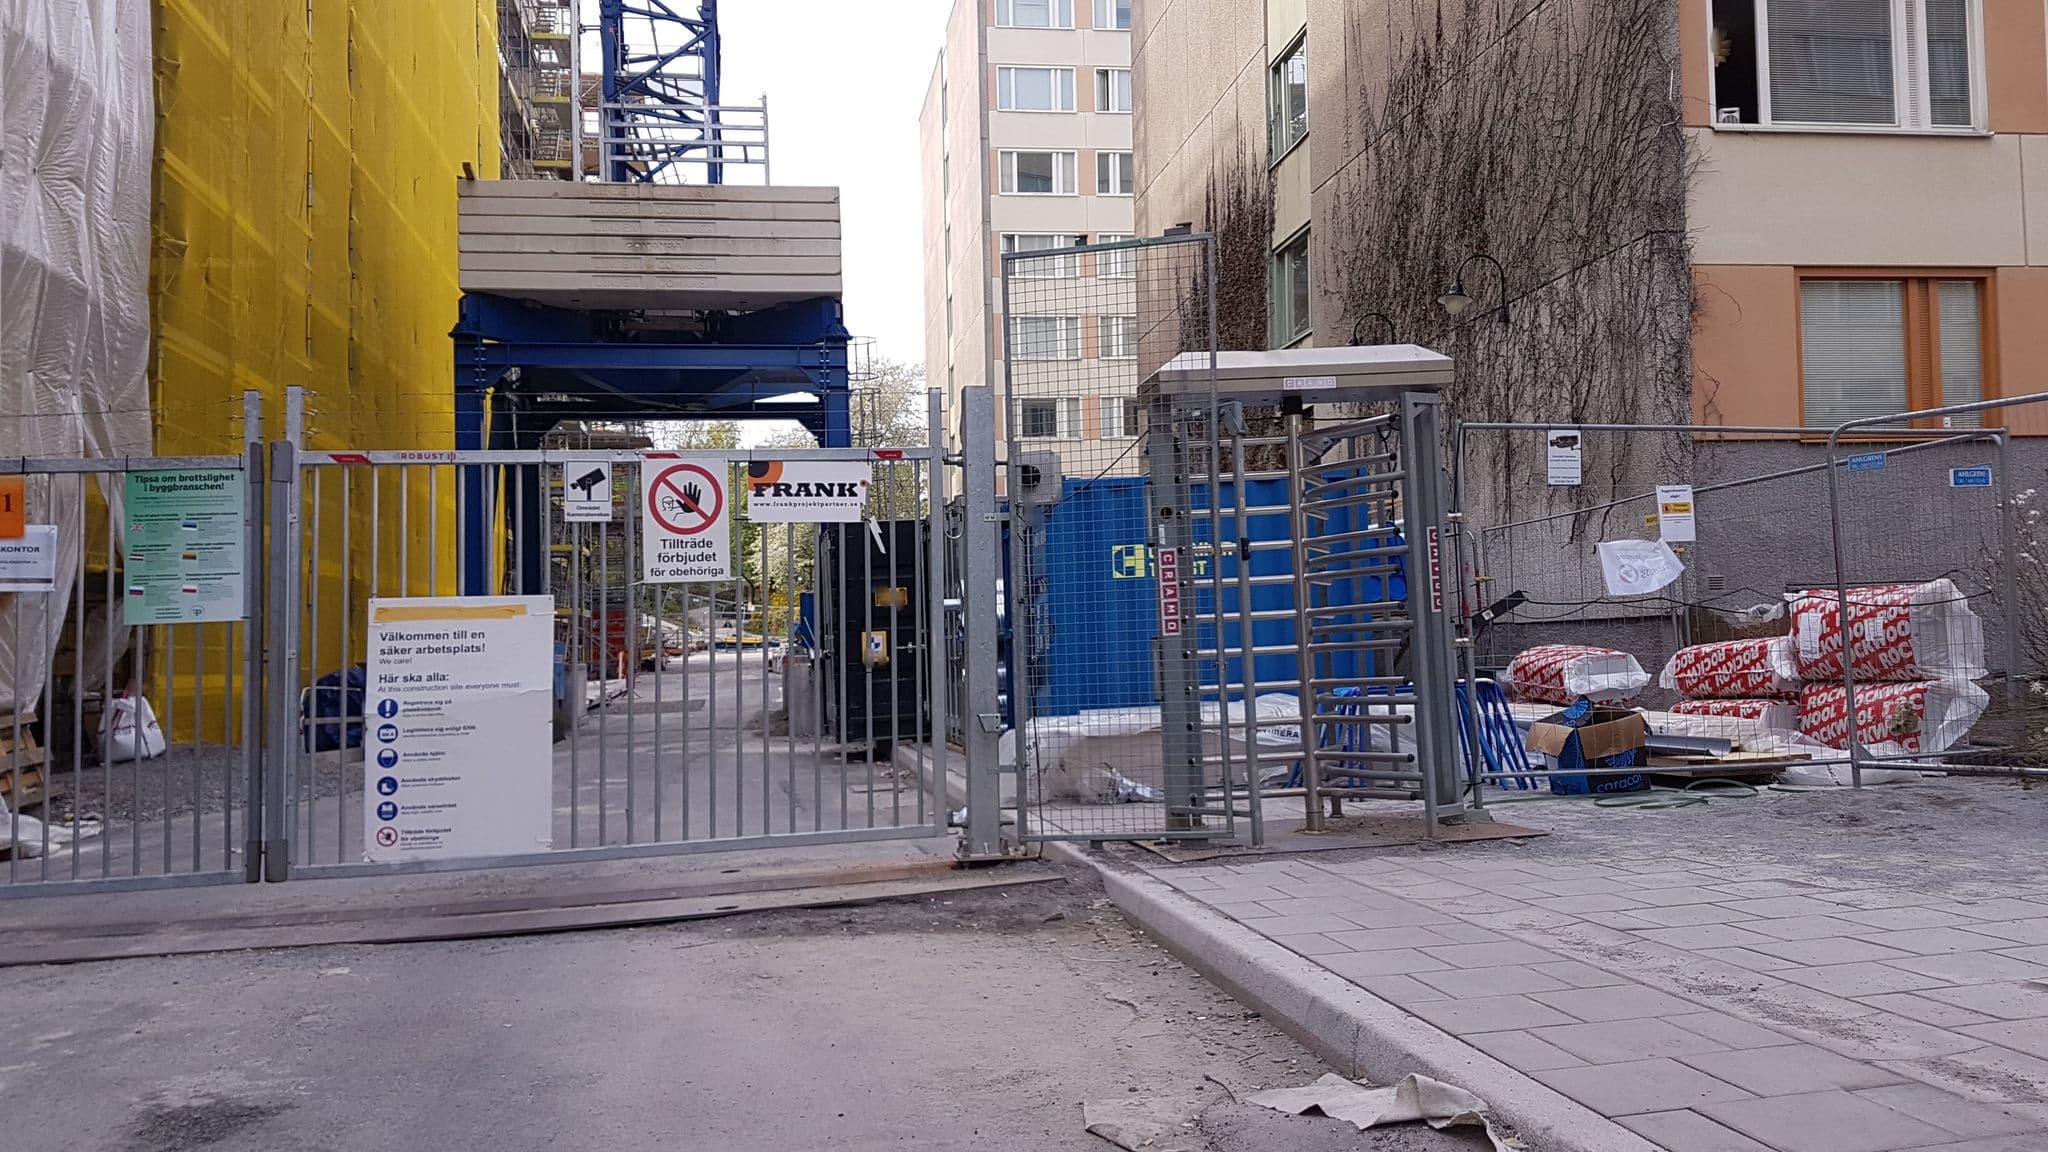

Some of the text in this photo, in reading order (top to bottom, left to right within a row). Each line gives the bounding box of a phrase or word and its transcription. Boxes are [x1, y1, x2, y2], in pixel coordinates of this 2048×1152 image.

[401, 452, 443, 460] ROBUST
[134, 474, 159, 484] Tipsa
[178, 473, 234, 484] brottslighet
[149, 482, 224, 493] byggbranschen!
[753, 482, 858, 498] FRANK
[3, 492, 12, 512] 1
[660, 538, 714, 550] Tillträde
[657, 552, 717, 565] förbjudet
[650, 566, 725, 578] för obehöriga
[1161, 551, 1179, 632] CRAMO
[380, 630, 485, 642] Välkommen till en
[380, 642, 486, 656] säker arbetsplats!
[394, 656, 412, 665] care!
[378, 672, 450, 684] Här ska alla:
[388, 685, 401, 693] this
[402, 684, 448, 692] construction
[450, 683, 464, 691] site
[465, 682, 500, 692] everyone
[1597, 773, 1642, 793] caracol
